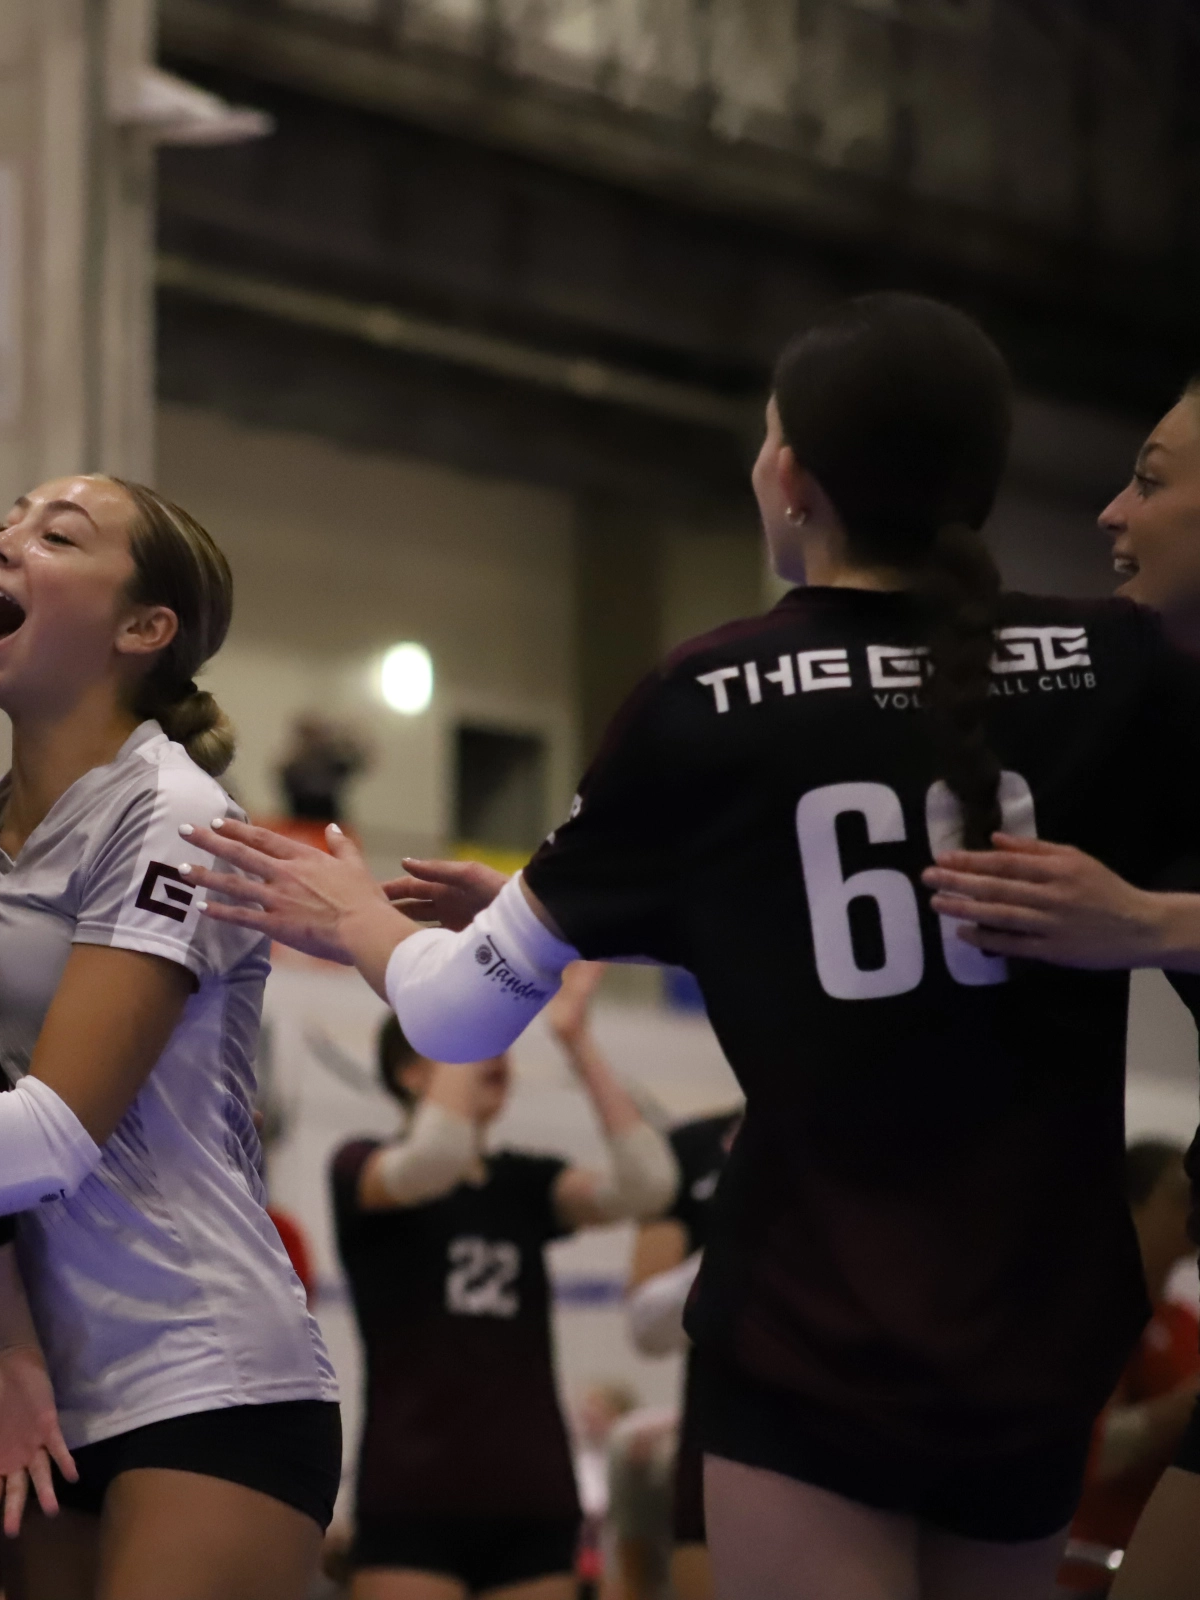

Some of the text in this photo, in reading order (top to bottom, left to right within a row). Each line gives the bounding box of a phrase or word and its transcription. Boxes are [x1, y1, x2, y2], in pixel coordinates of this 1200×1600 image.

[696, 648, 852, 713] THE
[1038, 672, 1097, 692] CLUB
[444, 1235, 522, 1320] 22
